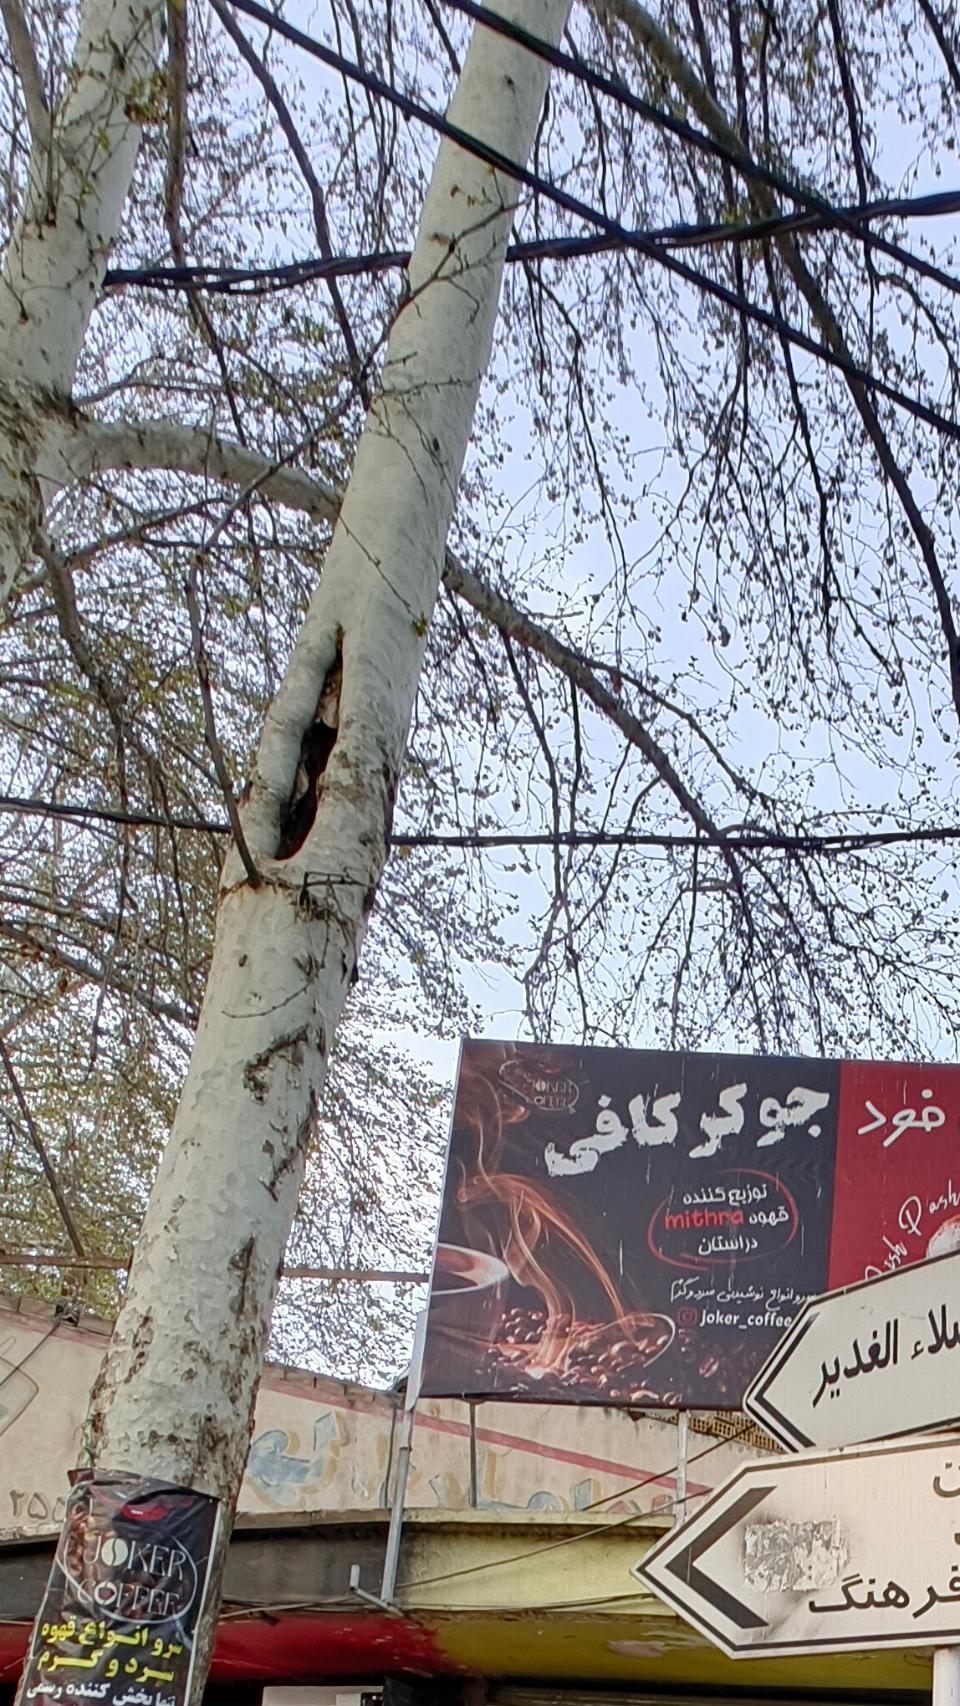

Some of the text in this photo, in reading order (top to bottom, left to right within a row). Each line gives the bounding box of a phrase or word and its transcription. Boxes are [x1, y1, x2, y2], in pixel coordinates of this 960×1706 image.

[544, 1083, 830, 1177] جوکر کافی
[664, 1206, 789, 1231] قهوه mithra
[811, 1319, 899, 1408] الغدیر
[83, 1535, 187, 1581] JOKER
[41, 1615, 77, 1643] قهوه
[78, 1620, 149, 1648] انواع
[105, 1658, 119, 1678] و
[124, 1656, 175, 1682] سرد
[65, 1682, 111, 1699] کننده
